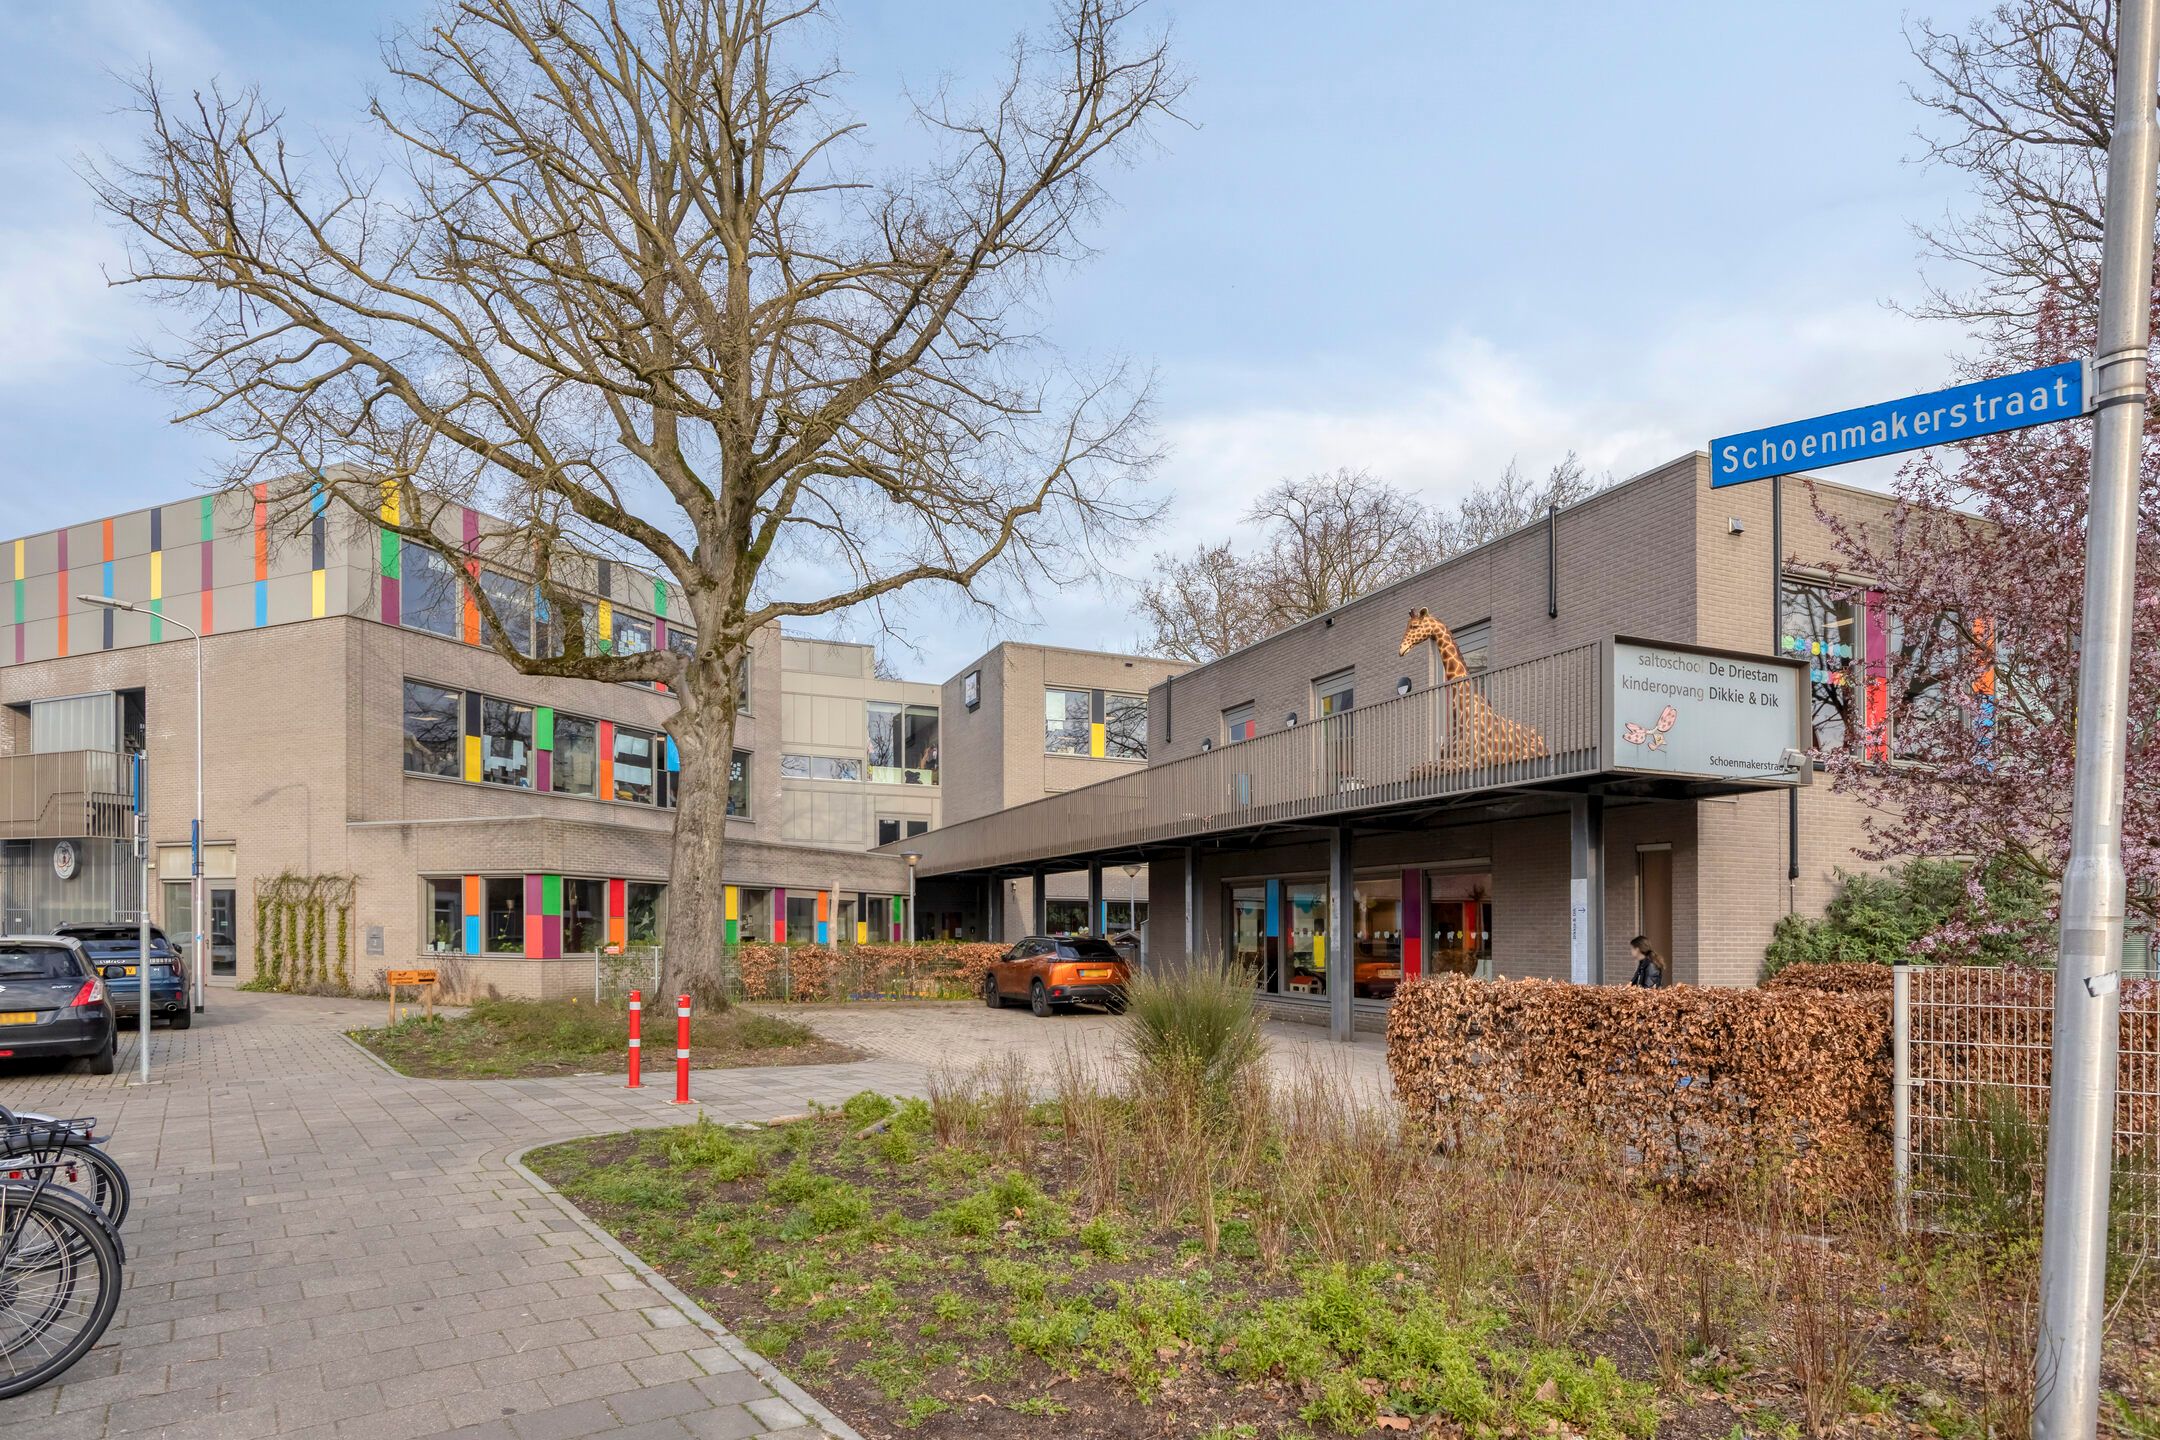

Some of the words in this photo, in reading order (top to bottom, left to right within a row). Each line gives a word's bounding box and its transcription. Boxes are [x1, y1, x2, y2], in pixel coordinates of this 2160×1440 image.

[1722, 376, 2069, 474] Schoenmakerstraat
[1709, 662, 1725, 676] De
[1728, 664, 1779, 684] Driestam
[1622, 675, 1704, 702] kinderopvang
[1709, 687, 1745, 704] Dikkie
[1748, 692, 1757, 706] &
[1760, 693, 1779, 708] Dik
[1709, 756, 1785, 772] Schoenmakerstraa
